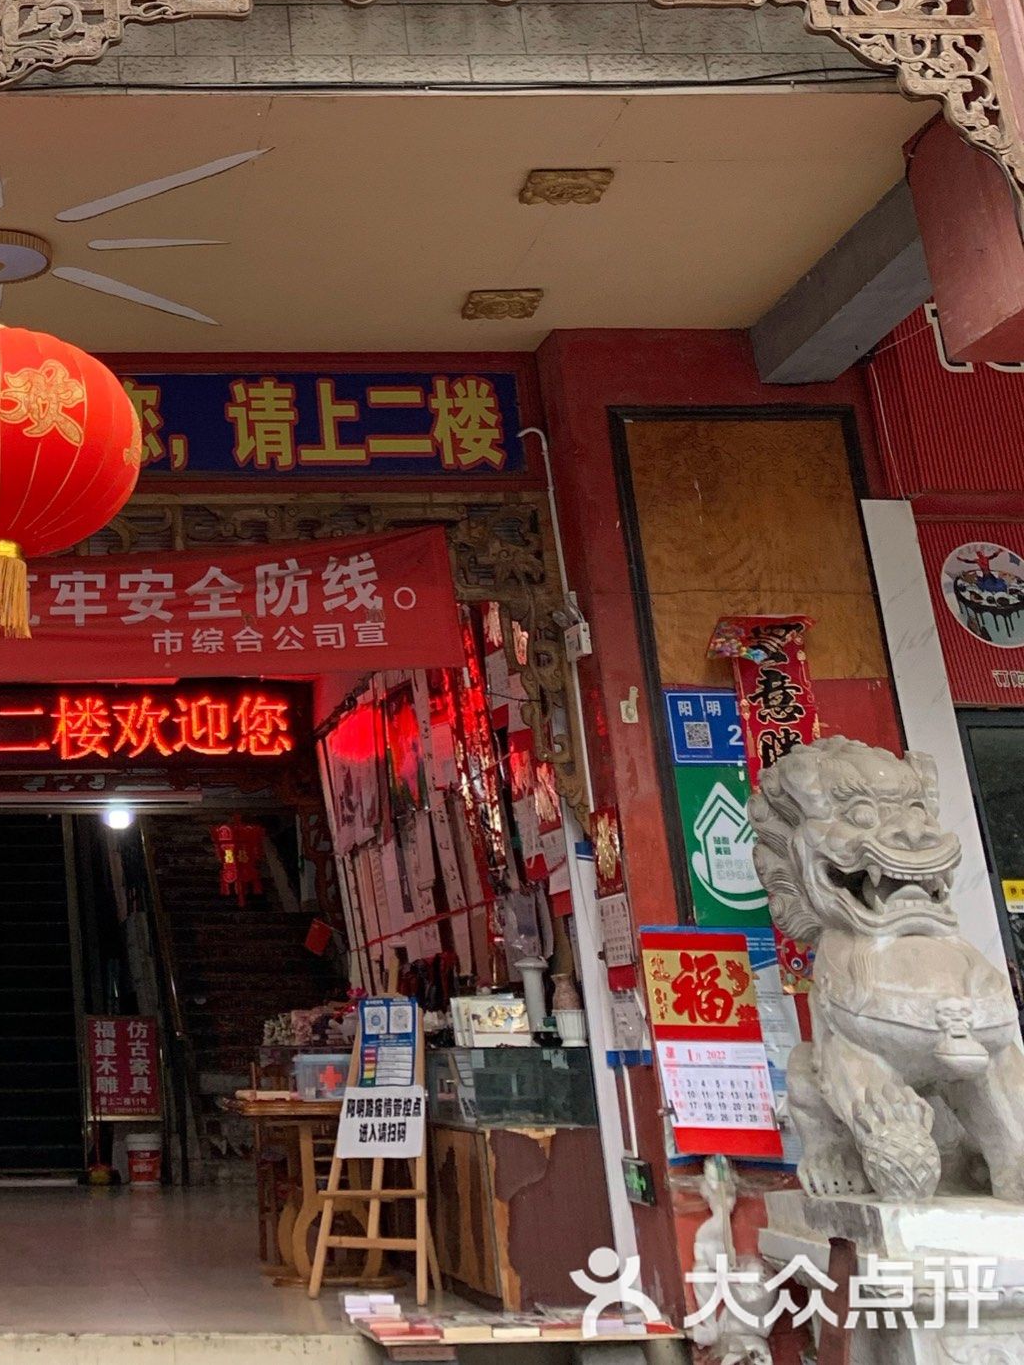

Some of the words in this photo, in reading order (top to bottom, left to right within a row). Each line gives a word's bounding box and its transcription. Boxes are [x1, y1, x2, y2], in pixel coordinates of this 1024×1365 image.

[152, 620, 389, 656] 市综合公司宣
[678, 700, 739, 717] 阳明
[671, 952, 734, 1024] 福
[93, 1021, 119, 1094] 福建木雕
[127, 1021, 152, 1094] 仿古家具
[706, 1050, 727, 1060] 2022
[346, 1097, 422, 1119] 阳明路疫情管控点
[359, 1123, 407, 1143] 进入请扫码
